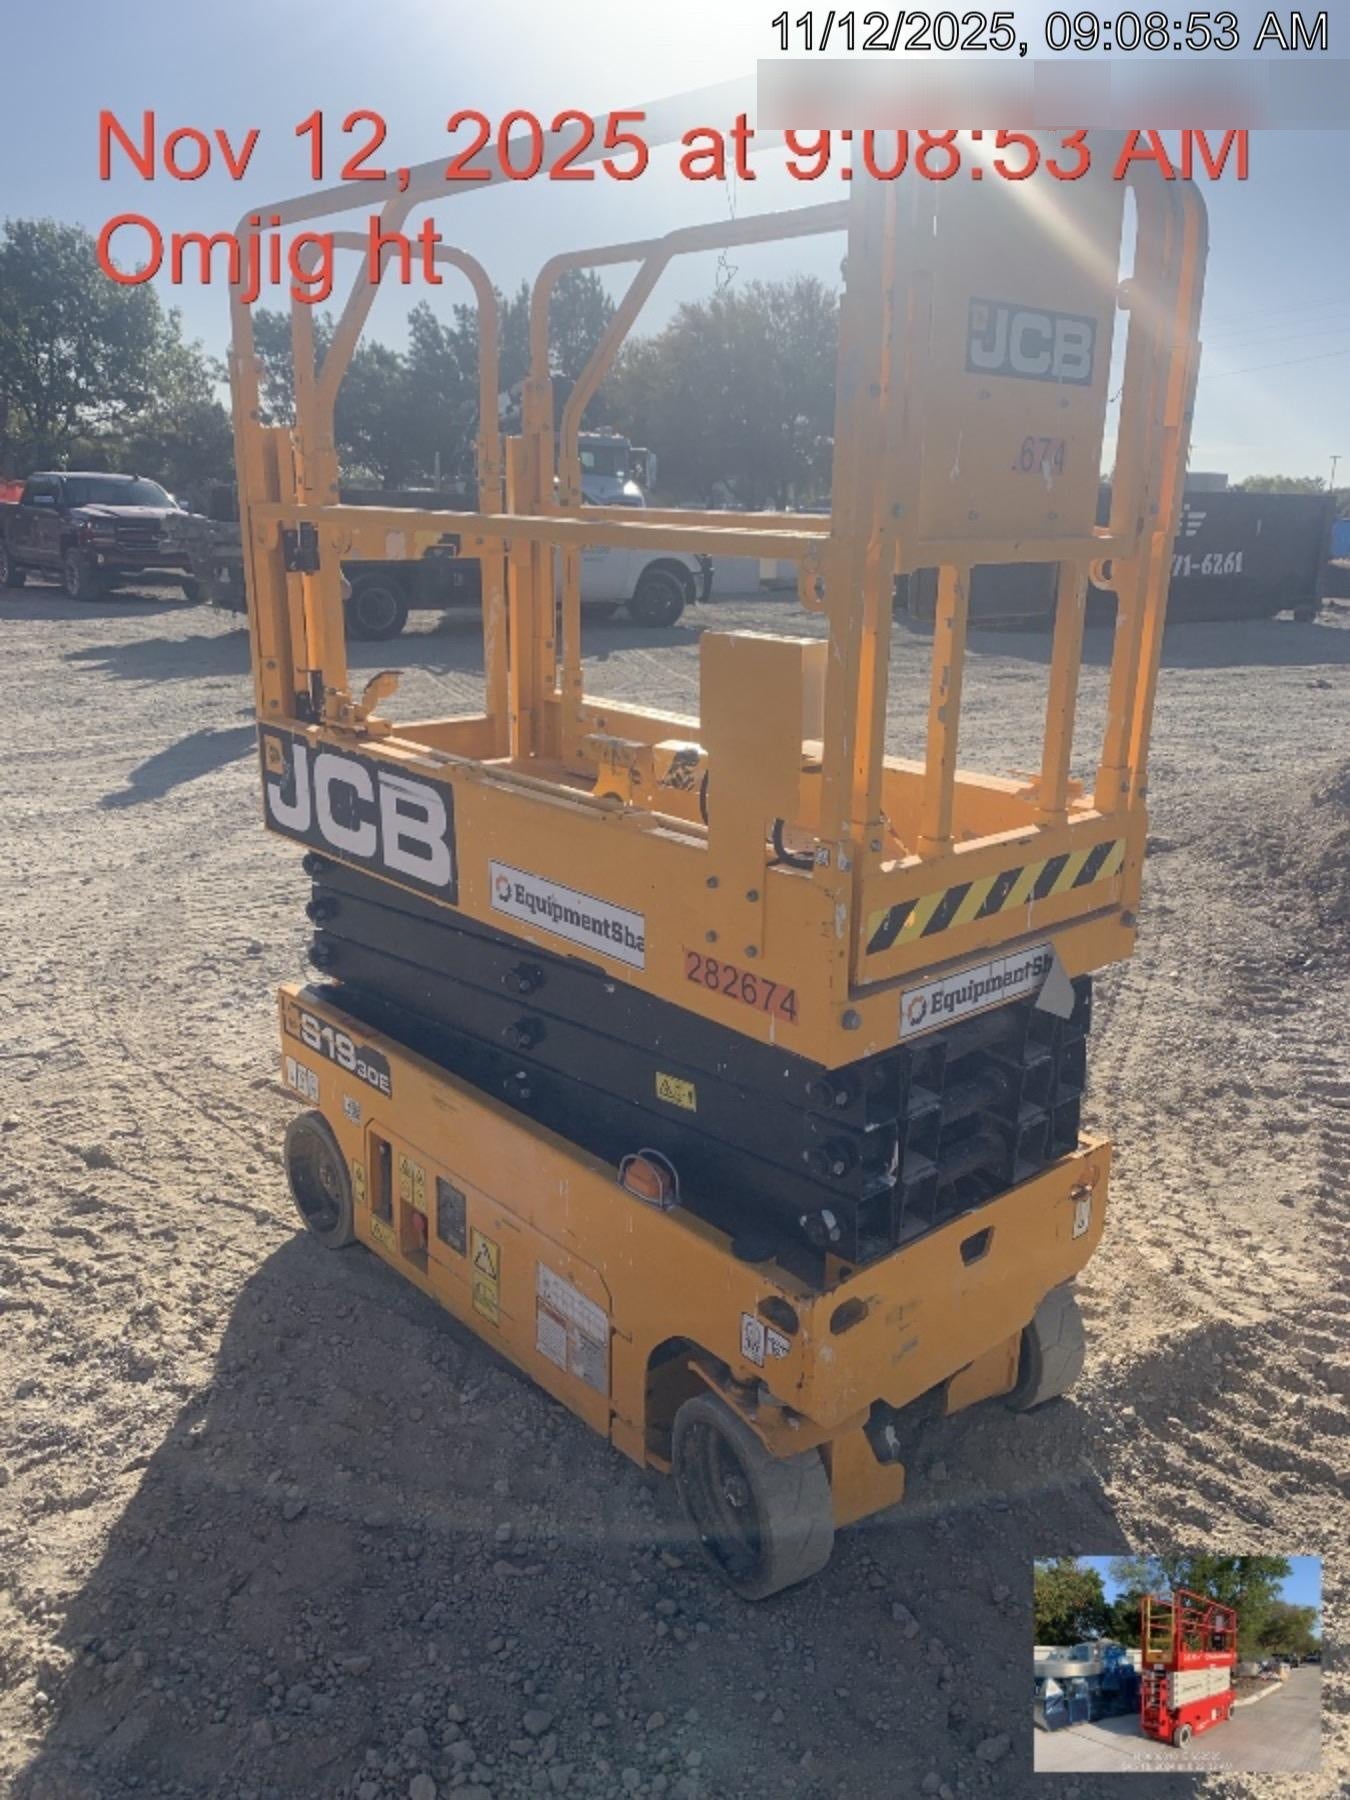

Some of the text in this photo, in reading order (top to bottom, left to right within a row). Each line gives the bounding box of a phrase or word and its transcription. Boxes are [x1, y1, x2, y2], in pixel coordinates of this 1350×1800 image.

[969, 303, 1094, 380] JCB
[267, 743, 452, 887] JCB
[686, 950, 797, 1020] 282674
